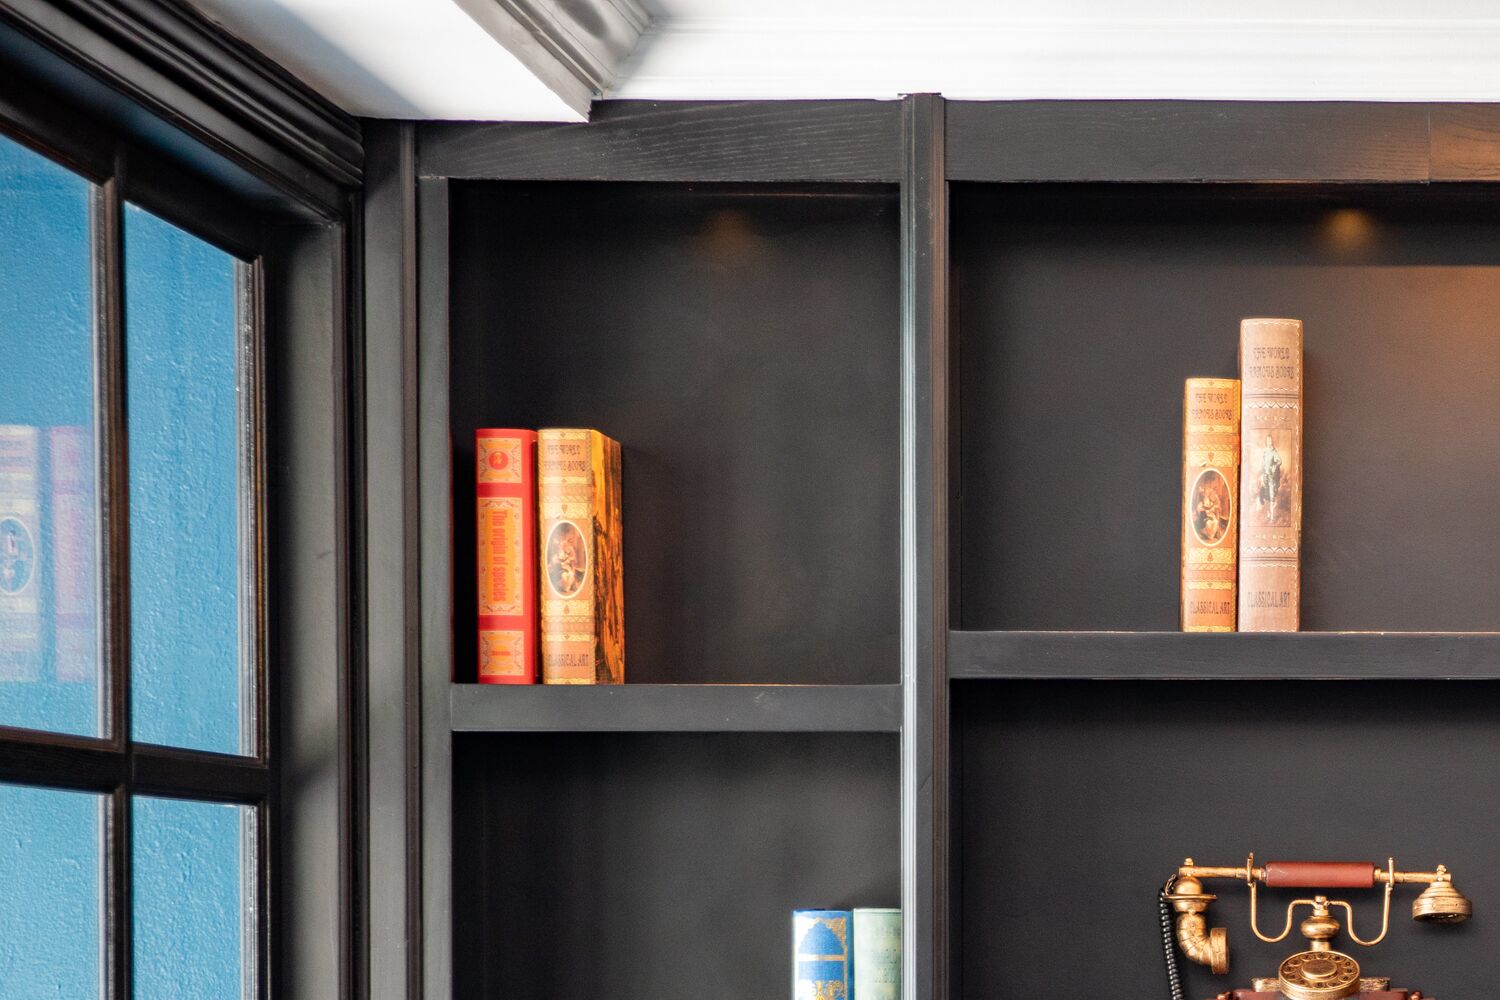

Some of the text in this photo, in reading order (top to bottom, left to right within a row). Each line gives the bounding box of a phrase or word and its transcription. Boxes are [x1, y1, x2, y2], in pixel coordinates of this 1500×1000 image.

[490, 510, 509, 602] The origin of species
[1190, 601, 1231, 615] CLASSICAL ART
[1247, 592, 1291, 608] CLASSICAL ART
